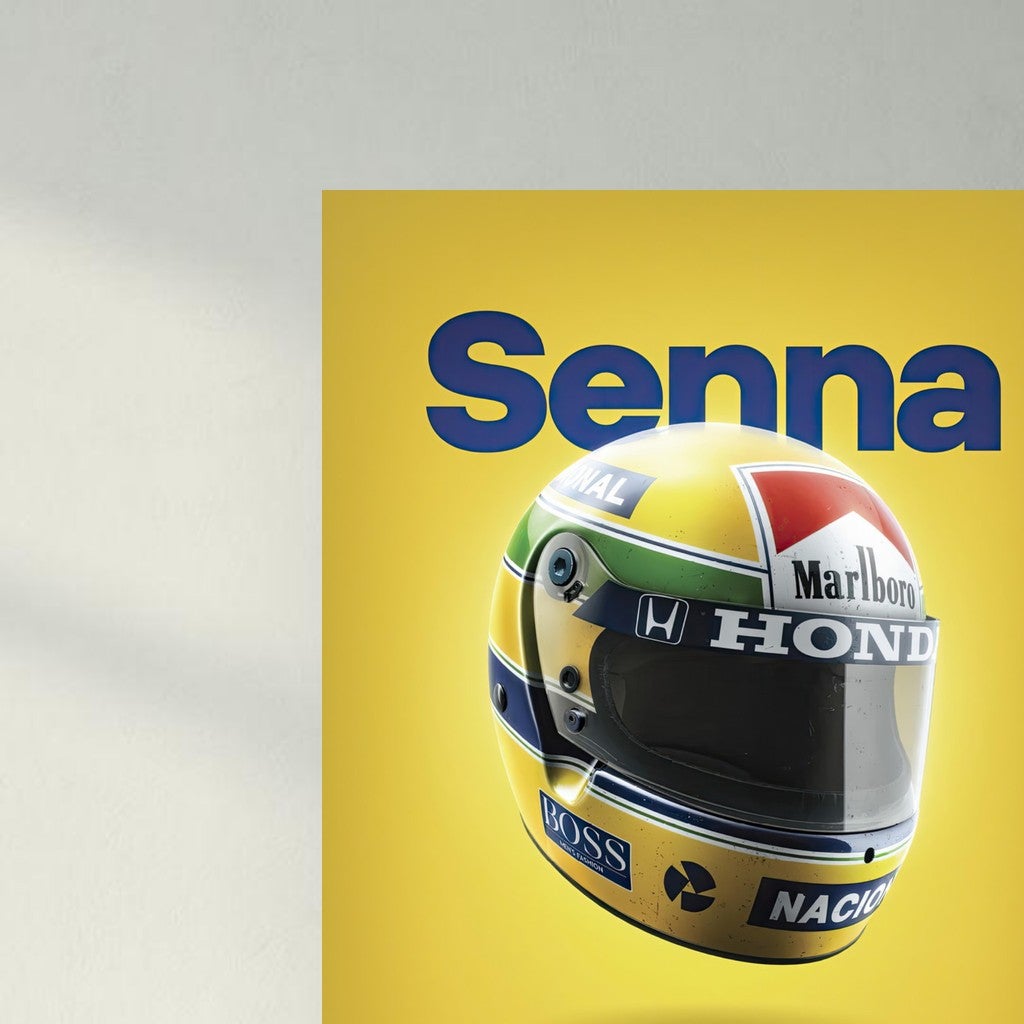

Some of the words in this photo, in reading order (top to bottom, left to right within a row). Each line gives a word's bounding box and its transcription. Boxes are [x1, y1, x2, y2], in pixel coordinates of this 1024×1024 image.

[426, 310, 1002, 453] Senna
[791, 545, 916, 610] Marlboro
[542, 794, 626, 872] BOSS
[576, 851, 604, 874] FASHION
